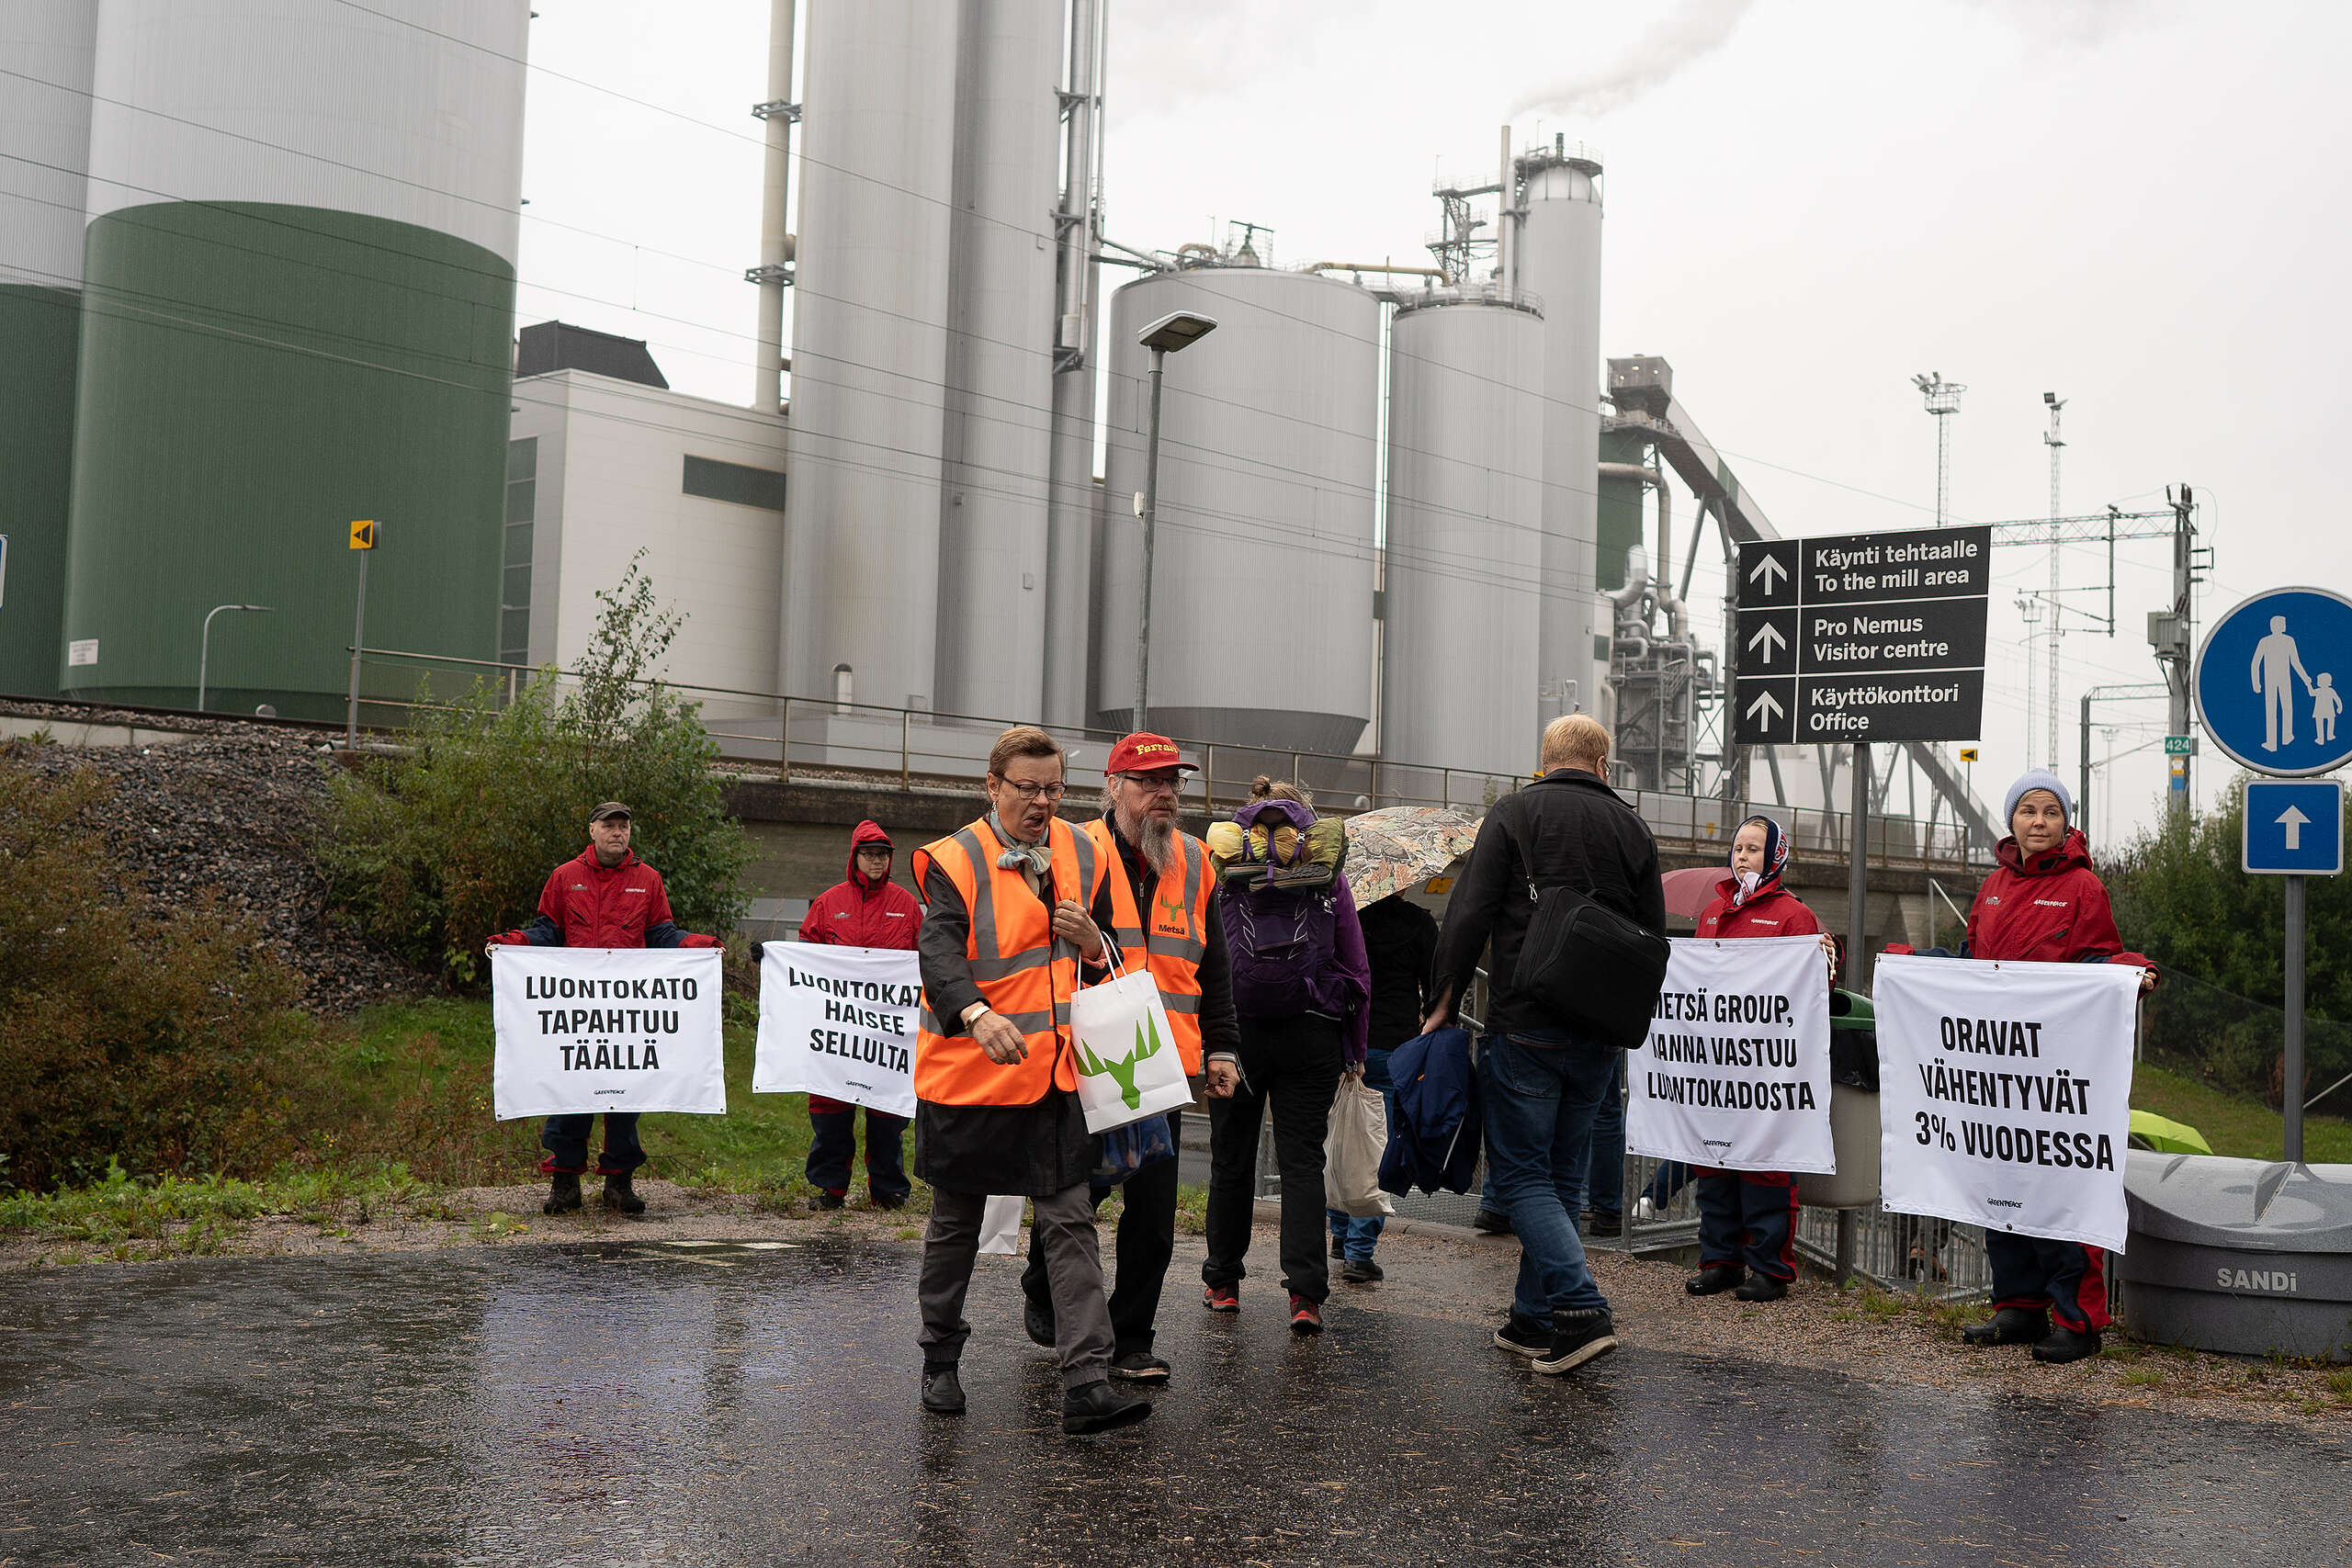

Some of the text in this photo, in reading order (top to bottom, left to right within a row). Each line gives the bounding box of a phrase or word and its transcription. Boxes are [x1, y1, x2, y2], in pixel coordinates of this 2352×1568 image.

[1815, 539, 1978, 570] Käynti tehtaalle
[1815, 568, 1970, 592] To the mill area
[1814, 616, 1924, 637] Pro Nemus
[1813, 639, 1949, 661] Visitor centre
[1811, 683, 1959, 709] Käyttökonttori
[1809, 712, 1870, 731] Office
[2166, 739, 2189, 751] 424
[1159, 924, 1185, 936] Metsä
[526, 976, 698, 1001] LUONTOKATO
[788, 966, 922, 1008] LUONTOKAT
[537, 1010, 679, 1035] TAPAHTUU
[825, 998, 905, 1037] HAISEE
[1713, 994, 1793, 1028] GROUP,
[809, 1028, 910, 1075] SELLULTA
[1710, 1037, 1798, 1068] VASTUU
[1940, 1016, 2042, 1058] ORAVAT
[560, 1039, 660, 1071] TÄÄLLÄ
[1647, 1071, 1816, 1111] LUONTOKADOSTA
[1917, 1057, 2090, 1115] VÄHENTYVÄT
[1915, 1111, 2115, 1172] 3% VUODESSA
[2217, 1268, 2297, 1292] SANDi
